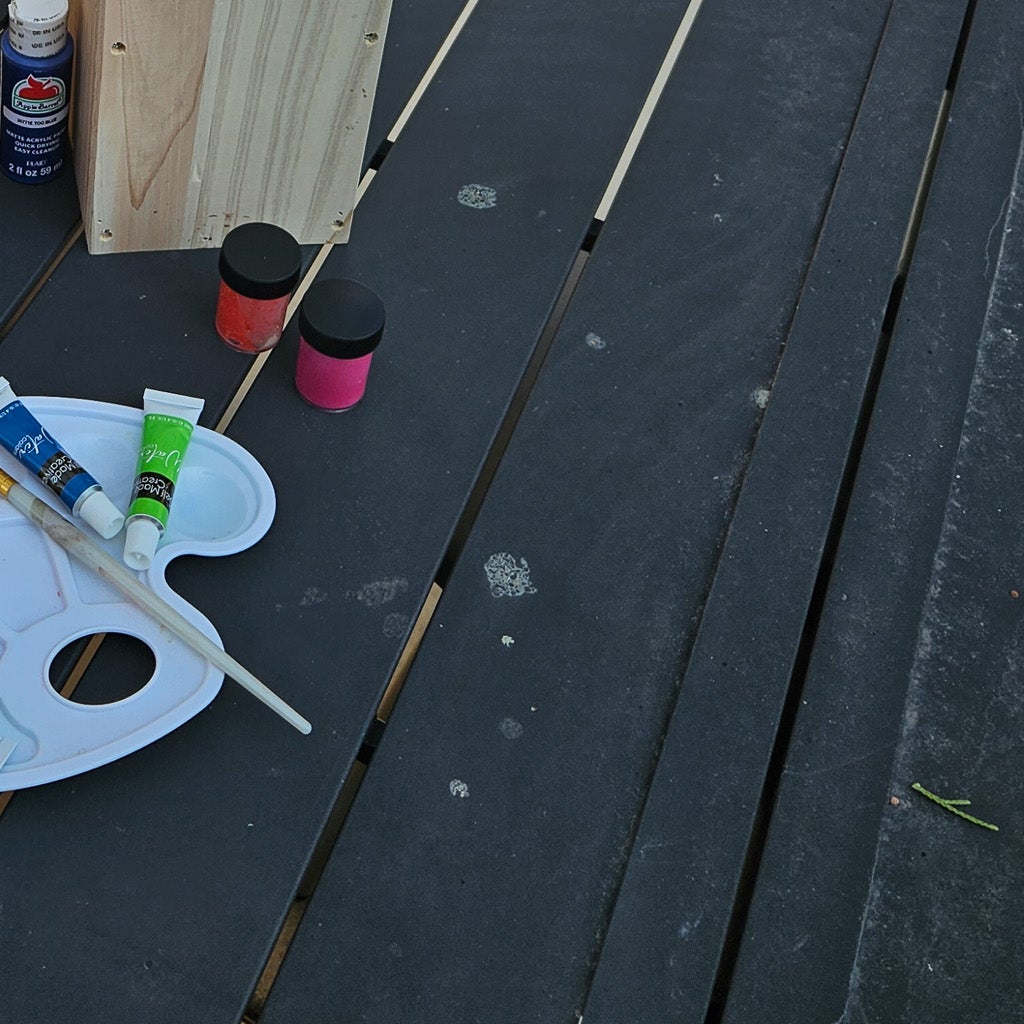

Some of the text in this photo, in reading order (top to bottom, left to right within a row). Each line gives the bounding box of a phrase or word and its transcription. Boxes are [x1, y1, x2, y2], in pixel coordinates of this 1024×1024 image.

[16, 101, 37, 111] Apple
[15, 140, 35, 149] QUICK
[14, 146, 30, 154] EASY
[16, 166, 22, 175] fl
[40, 166, 52, 176] 59
